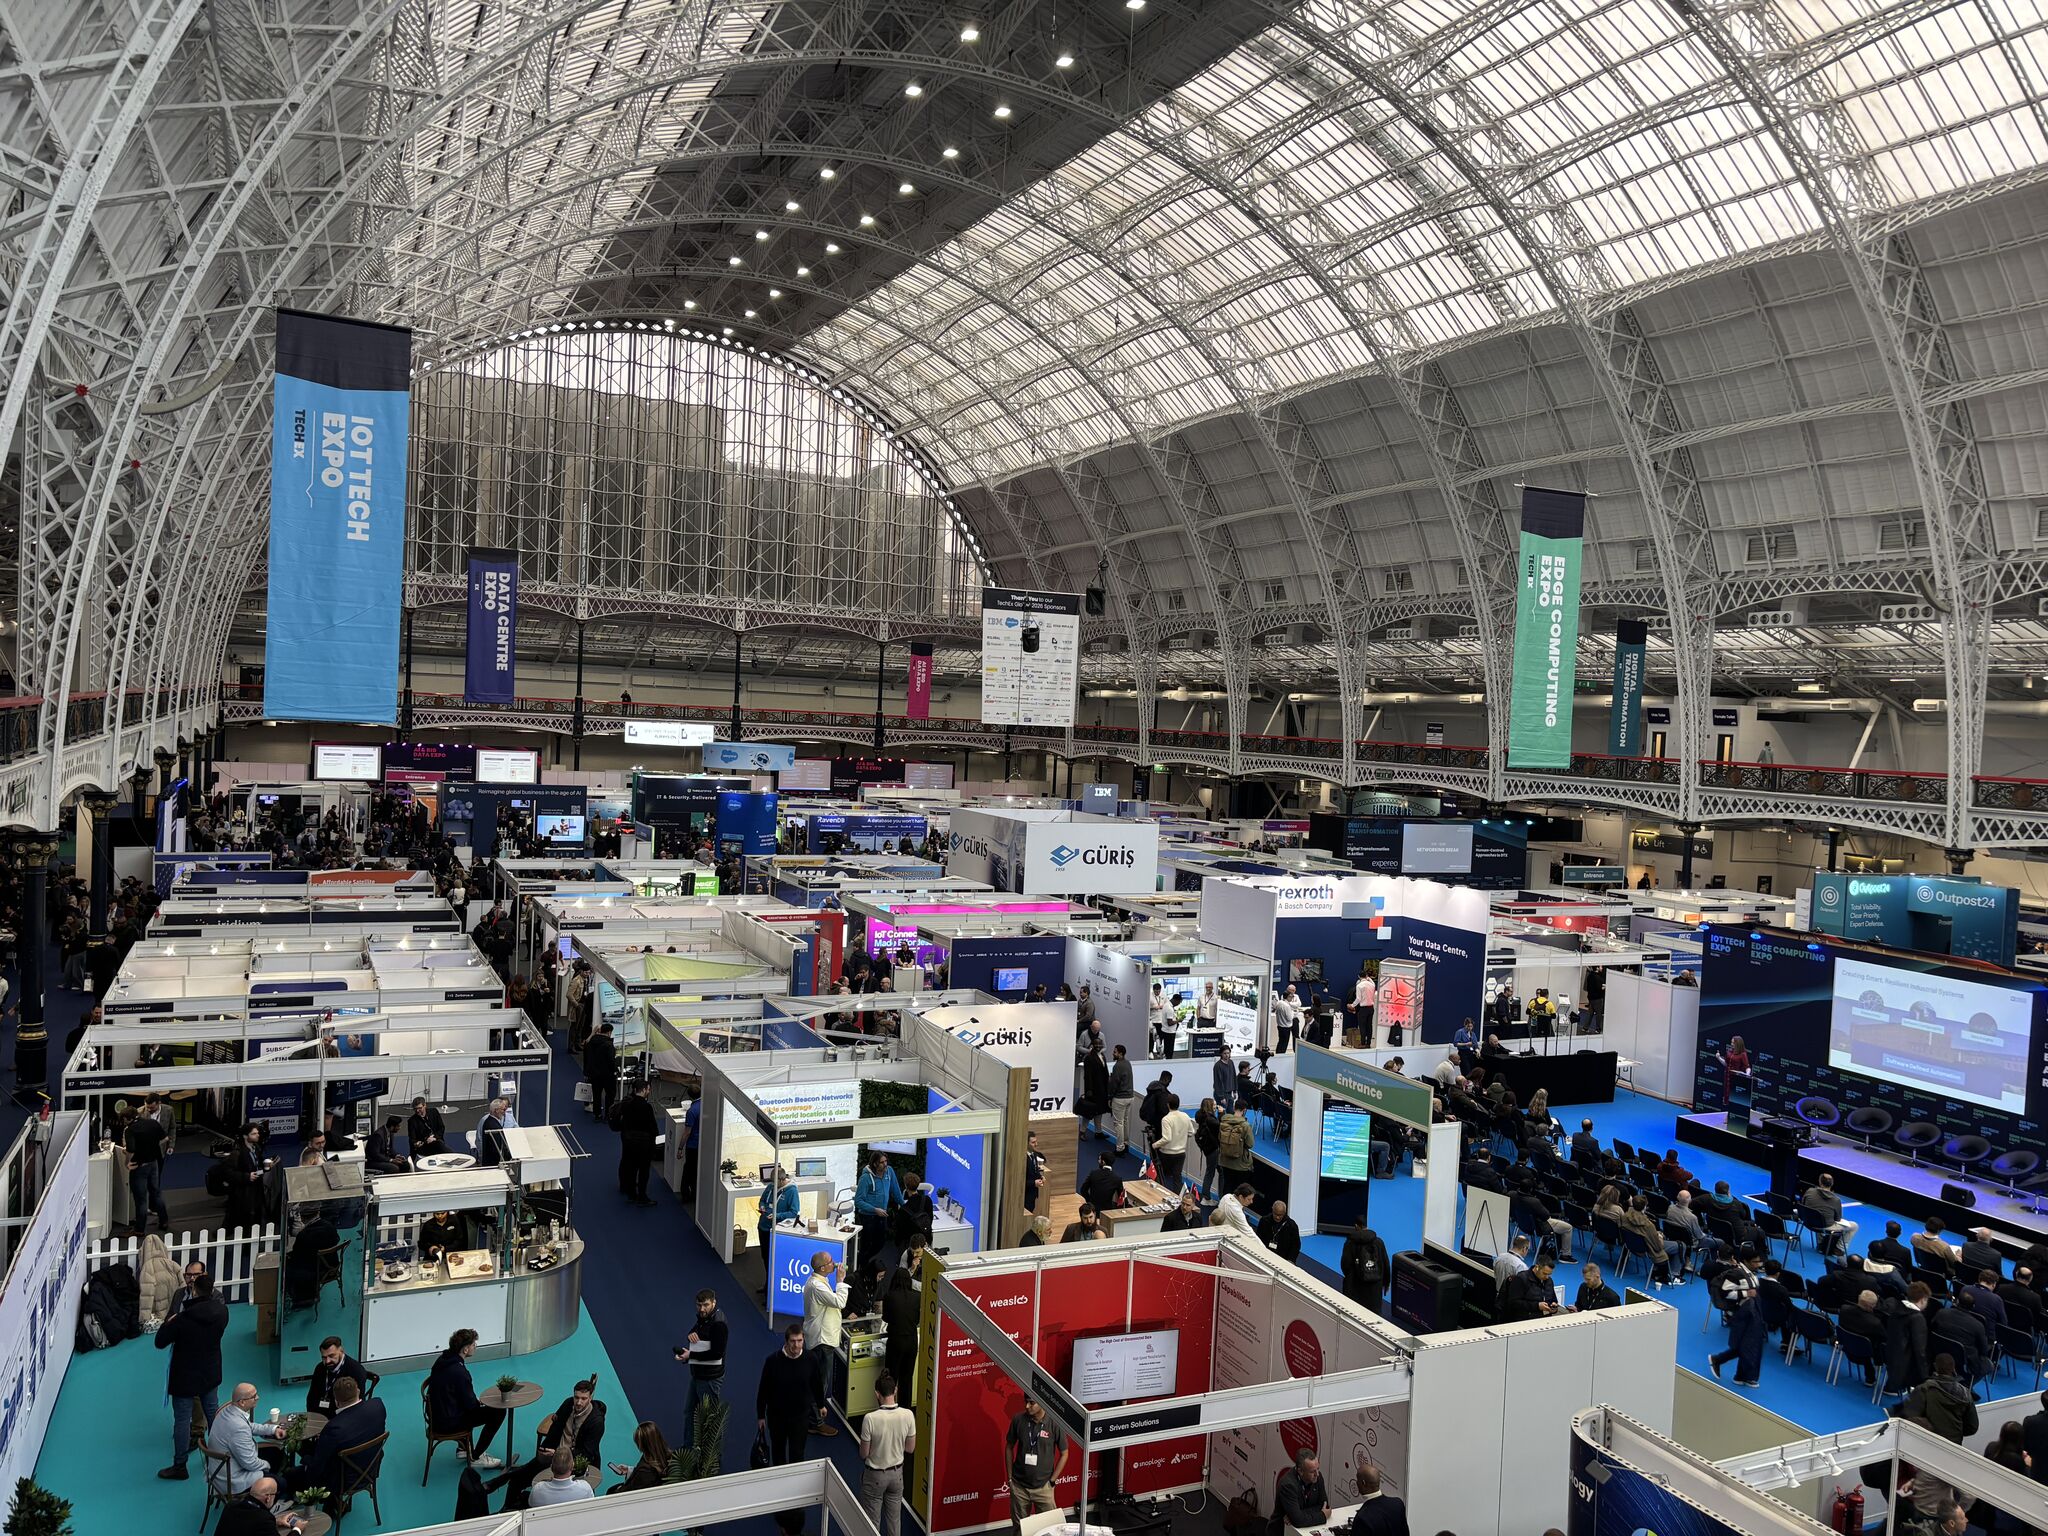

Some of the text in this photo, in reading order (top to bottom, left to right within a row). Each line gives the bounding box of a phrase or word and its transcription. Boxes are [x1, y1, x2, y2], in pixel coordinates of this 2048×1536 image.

[321, 412, 346, 488] EXPO
[347, 416, 374, 542] IOT TECH
[1539, 555, 1552, 607] EXPO
[484, 571, 497, 611] EXPO
[496, 572, 510, 671] DATA CENTRE
[987, 617, 1003, 625] IBM
[1544, 556, 1566, 727] EDGE COMPUTING
[1629, 653, 1638, 692] DIGITAL
[1619, 653, 1631, 748] TRANSFORMATION
[478, 788, 505, 796] Reimagine
[1094, 788, 1112, 796] IBM
[963, 836, 988, 860] GÜRİŞ
[1653, 839, 1665, 848] Lift
[1082, 845, 1134, 868] GÜRİŞ
[1278, 884, 1333, 900] rexroth
[1935, 890, 1996, 909] Outpost24
[1304, 903, 1333, 911] Company
[1850, 920, 1865, 928] Expert
[874, 930, 886, 939] IoT
[1710, 934, 1745, 948] IOT TECH
[1408, 935, 1468, 959] Your Data Centre,
[1408, 947, 1441, 963] Your Way.
[1710, 943, 1731, 953] EXPO
[1751, 942, 1826, 962] EDGE COMPUTING
[1751, 952, 1773, 961] EXPO
[1841, 969, 1965, 999] Creating Smart, Resilient Industrial Systems
[1886, 1057, 1961, 1080] Software Defined Automation
[1336, 1072, 1383, 1100] Entrance
[252, 1096, 296, 1107] iot insider
[759, 1093, 854, 1106] Bluetooth Beacon Networks
[936, 1138, 971, 1170] Beacon Networks
[1221, 1281, 1252, 1308] Capabilities
[947, 1347, 972, 1357] Future
[946, 1361, 995, 1372] Intelligent solutions
[946, 1371, 972, 1379] connected
[1094, 1418, 1159, 1434] 55 Sriven Solutions
[1181, 1453, 1198, 1463] Kong
[943, 1492, 979, 1504] CATERPILLAR
